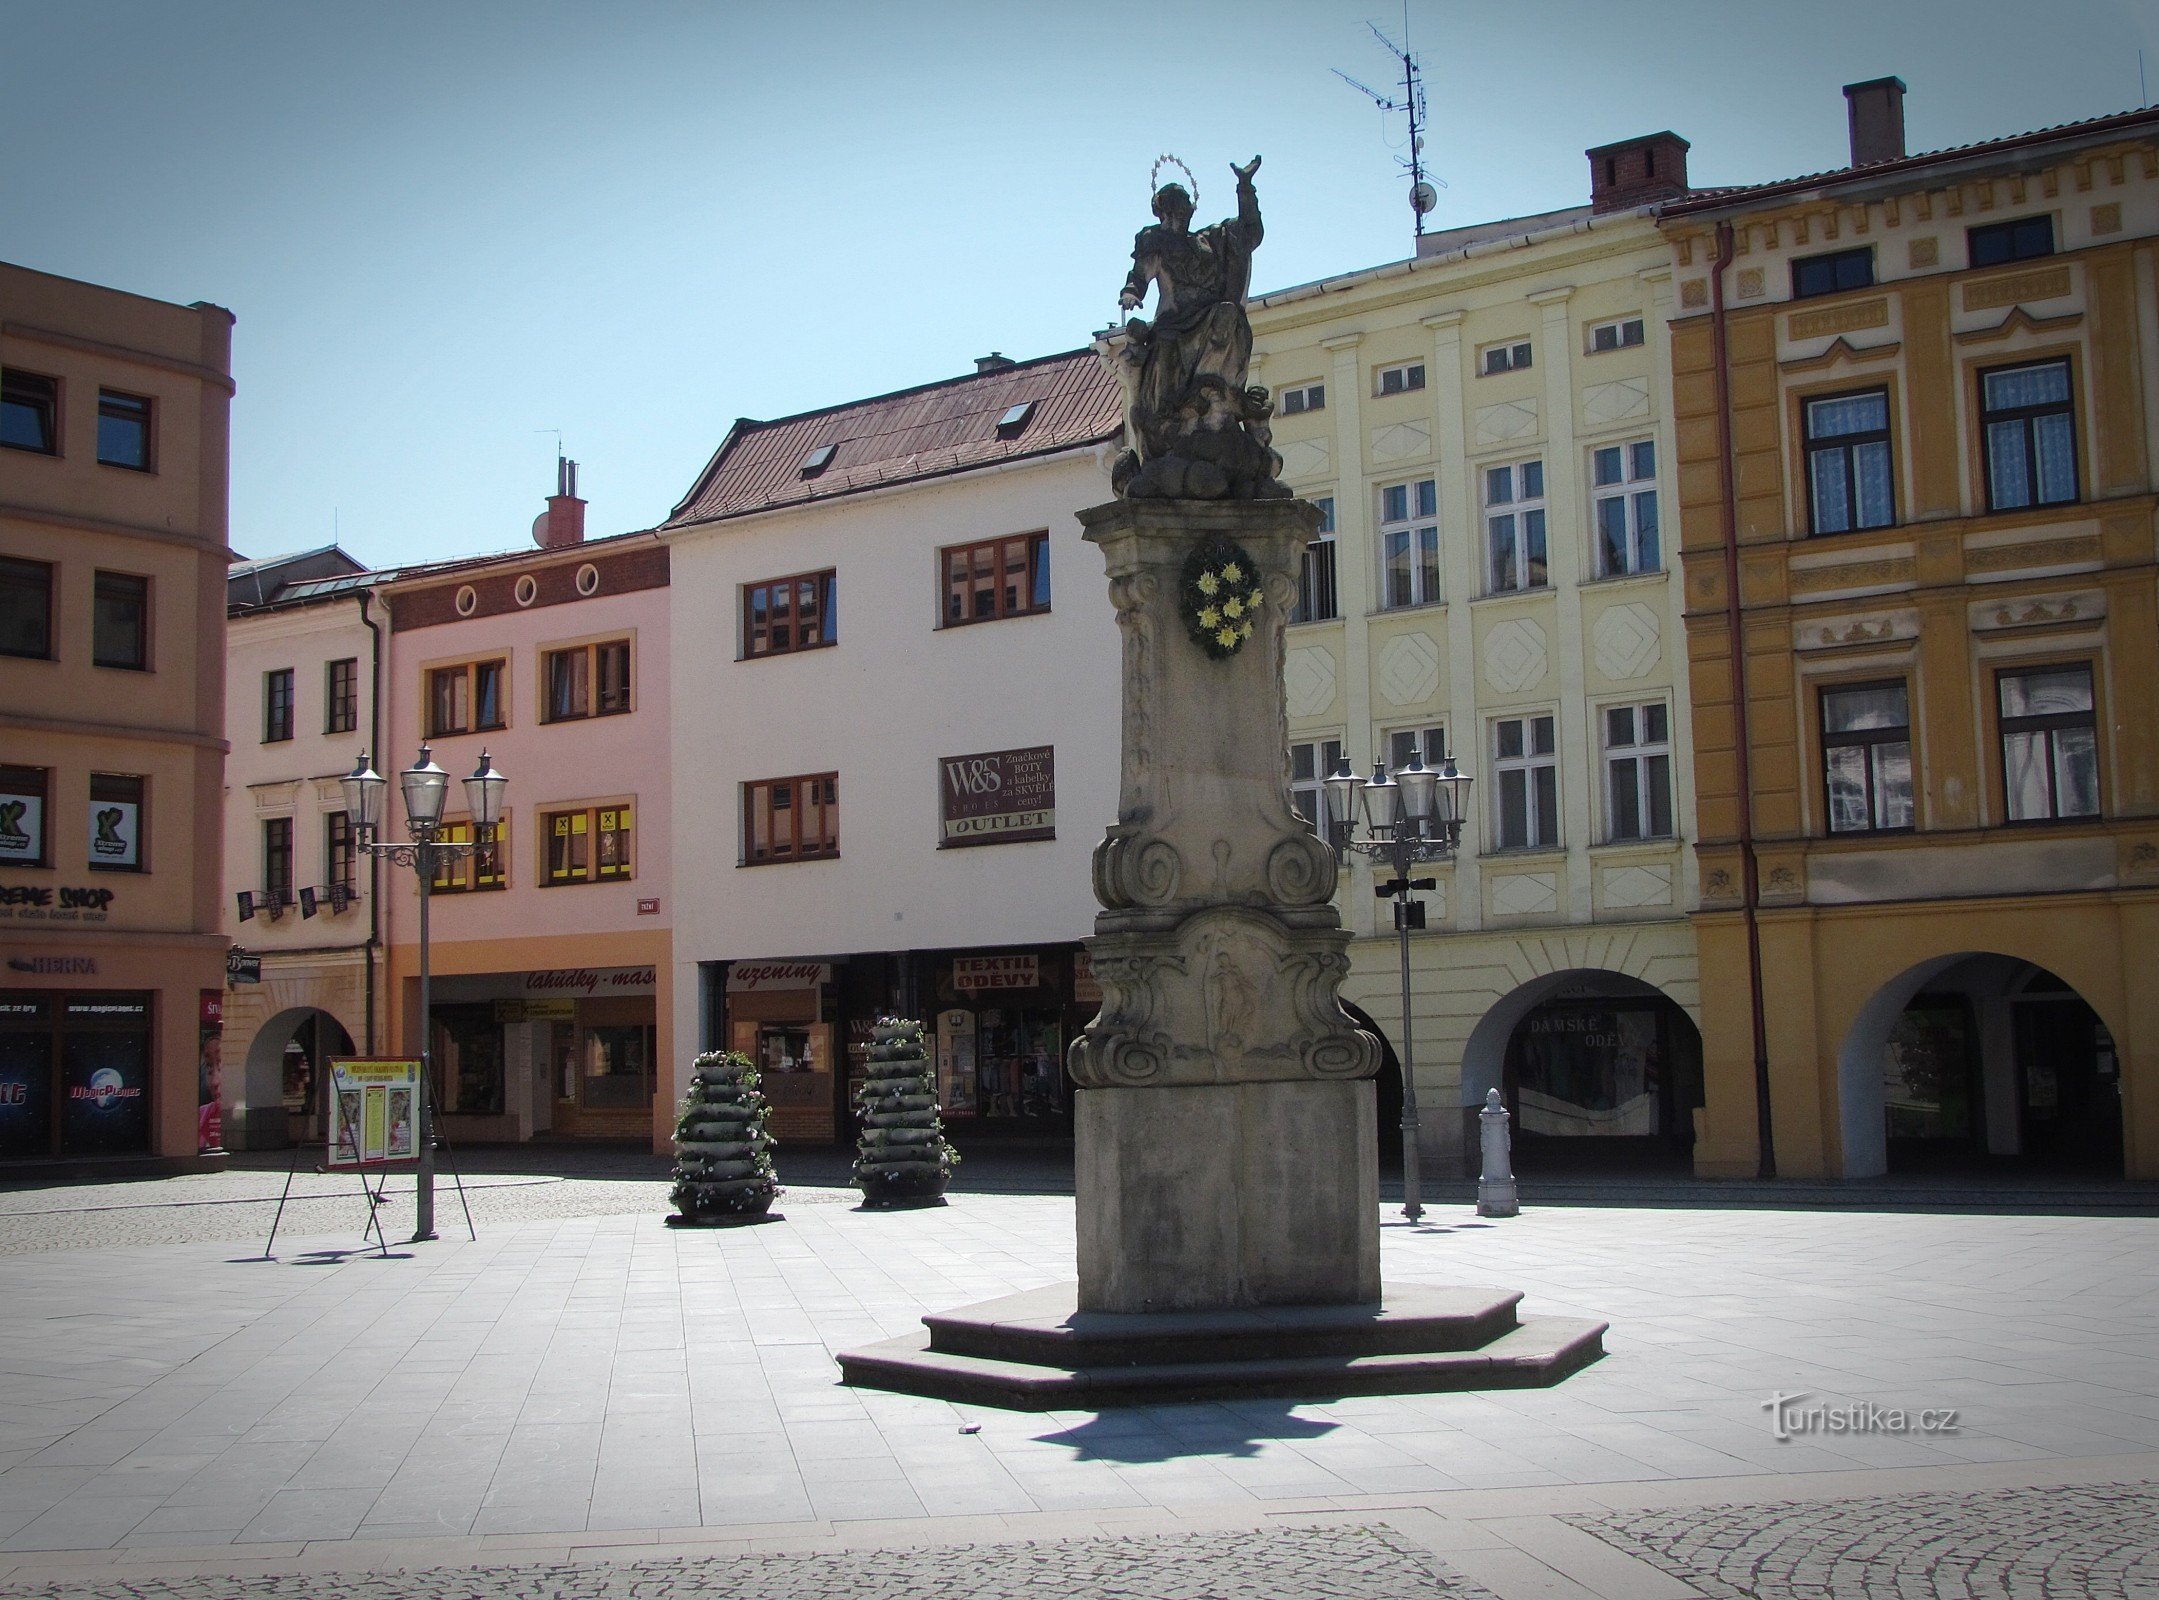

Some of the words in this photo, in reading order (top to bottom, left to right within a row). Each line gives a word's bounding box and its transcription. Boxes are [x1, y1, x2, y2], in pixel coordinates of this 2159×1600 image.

[1006, 750, 1051, 764] Značkové
[1014, 762, 1042, 774] BOTY
[946, 757, 1001, 797] W&S
[1015, 772, 1051, 785] kabelky
[1002, 788, 1013, 797] za
[1017, 795, 1041, 806] ceny!
[957, 811, 1048, 833] OUTLET
[59, 886, 114, 911] SHOP
[956, 957, 1035, 972] TEXTIL
[526, 969, 599, 993] lahůdky
[736, 962, 821, 988] uzeniny
[957, 972, 1034, 988] ODĚVY
